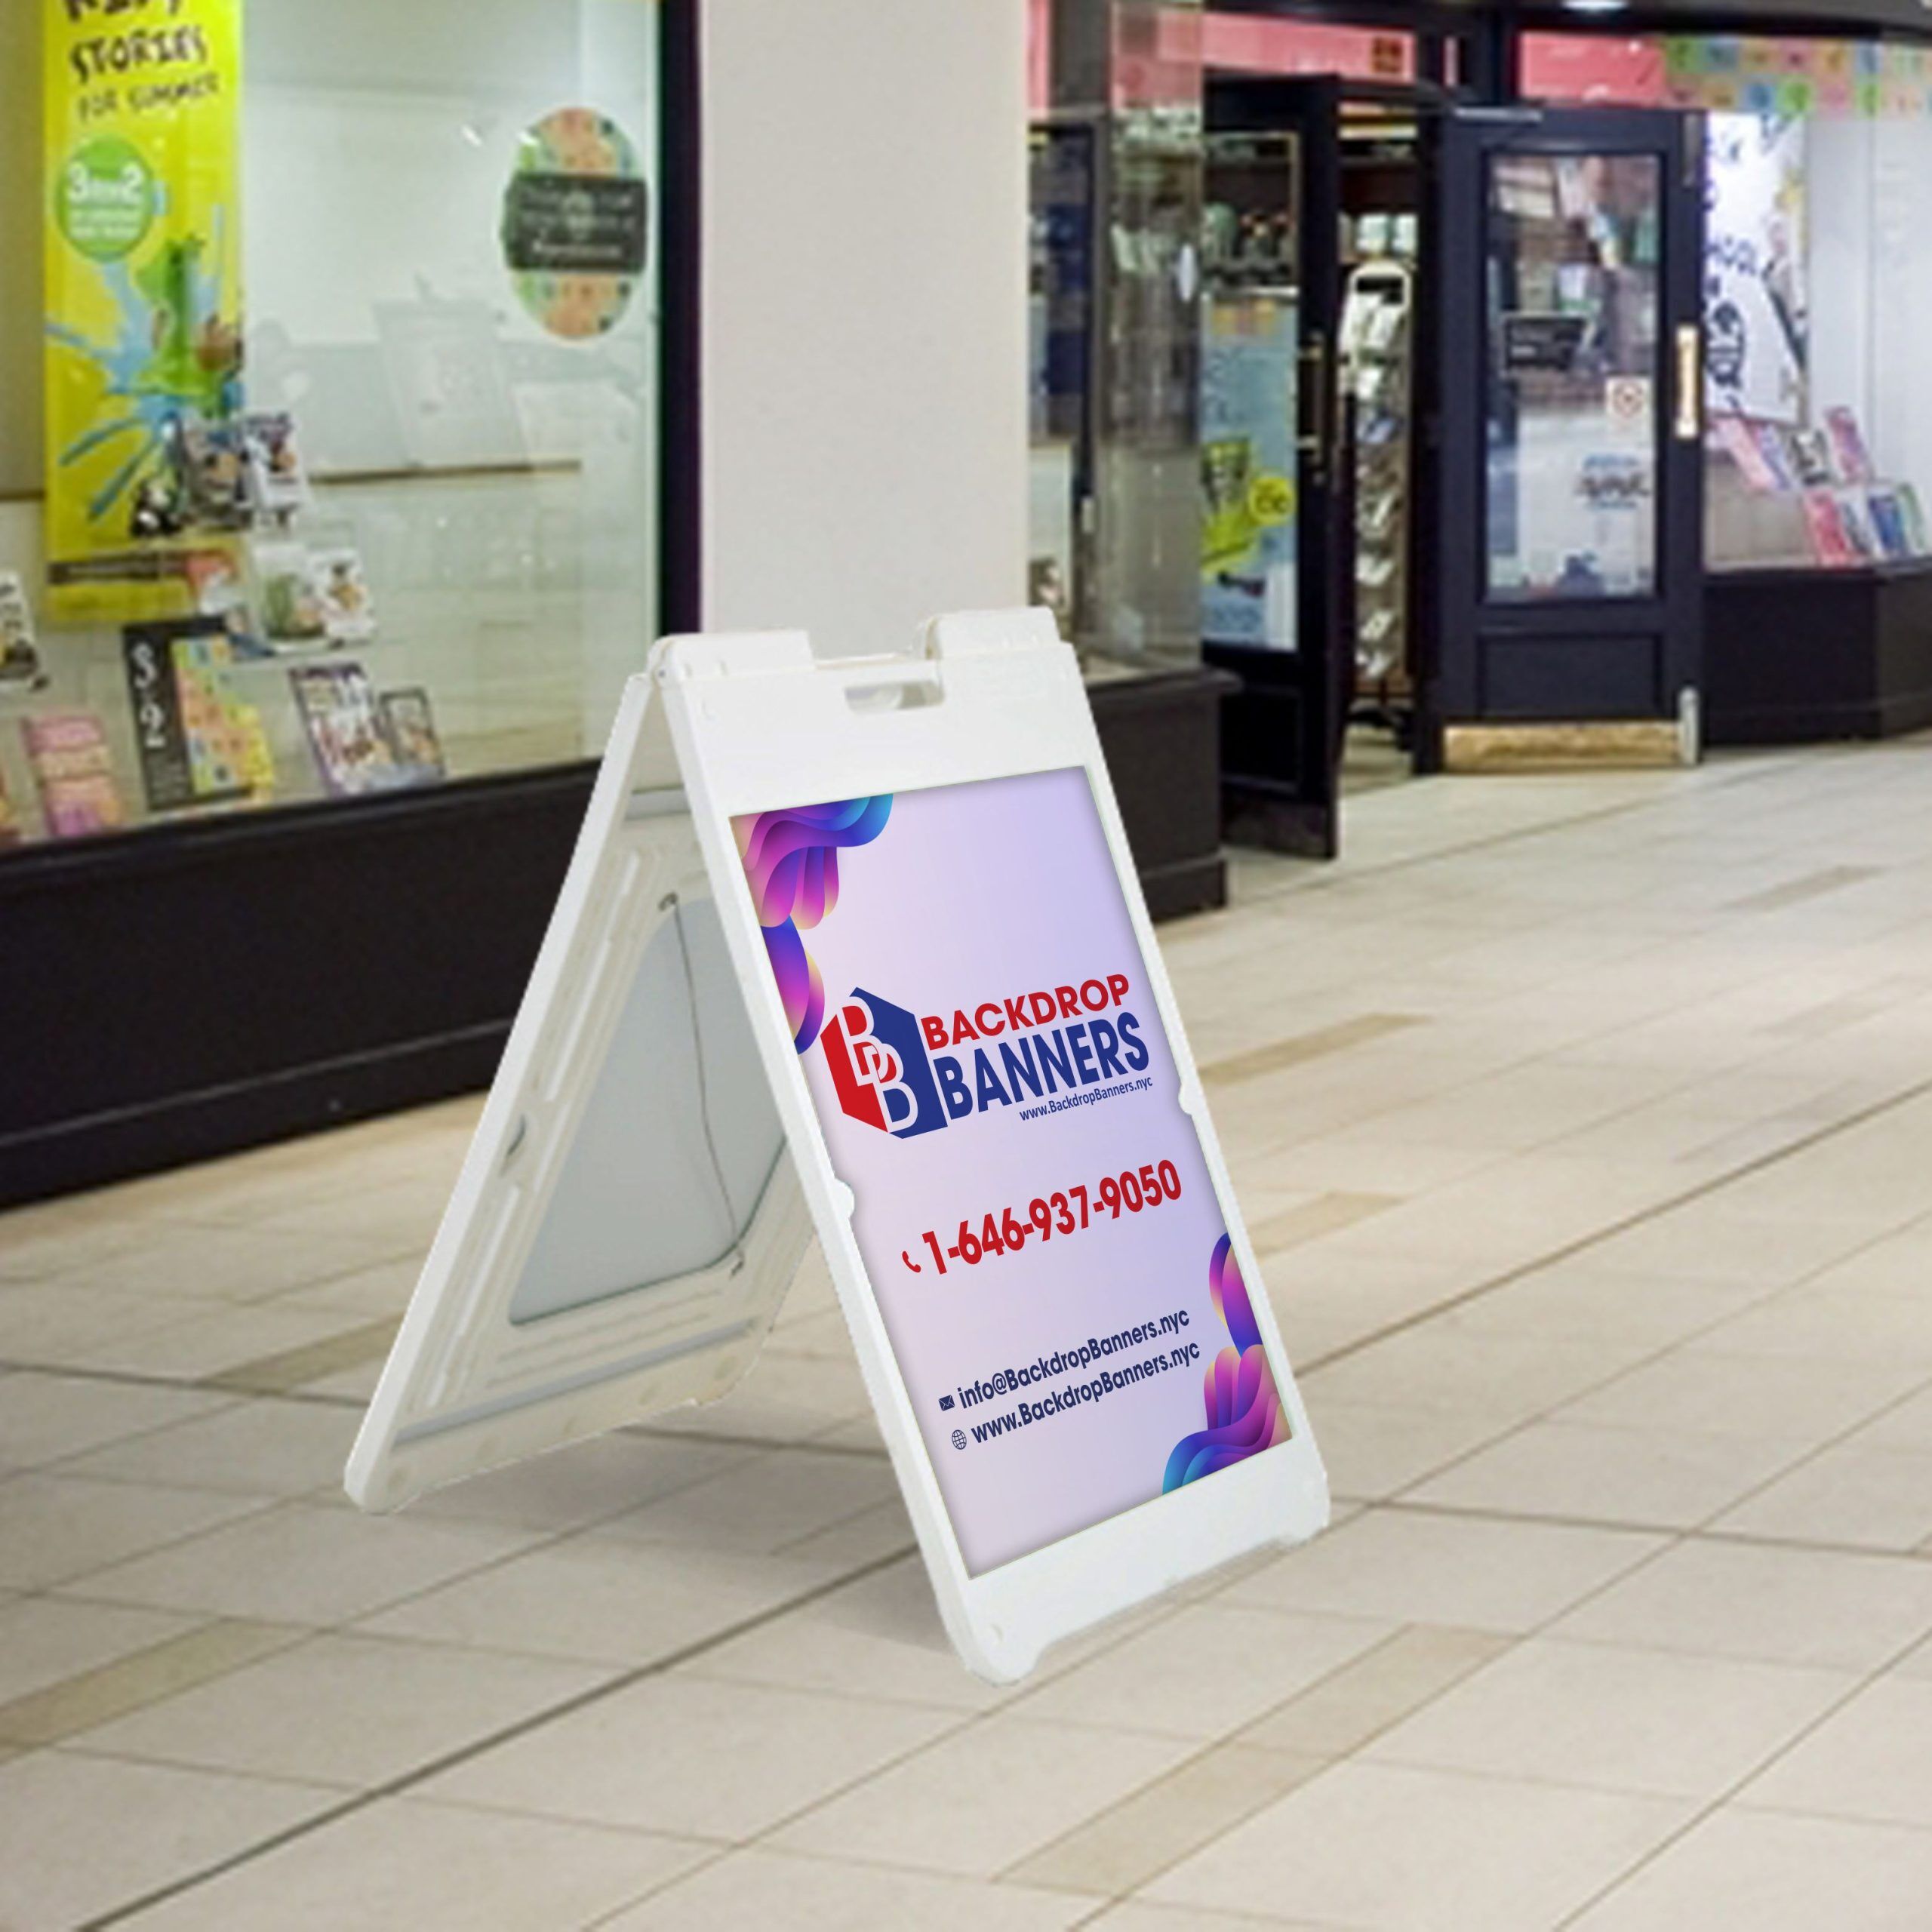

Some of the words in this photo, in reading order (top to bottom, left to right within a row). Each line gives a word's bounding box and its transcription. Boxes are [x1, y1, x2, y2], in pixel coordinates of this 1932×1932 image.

[70, 26, 208, 85] STORIES
[921, 974, 1130, 1051] BACKDROP
[933, 1011, 1150, 1121] BANNERS
[1019, 1076, 1153, 1121] www.BackdropBanners.nyc
[921, 1159, 1182, 1275] 1-646-937-9050
[957, 1309, 1190, 1409] info@BackdropBanners.nyc
[971, 1342, 1201, 1444] www.BackdropBanners.nyc
